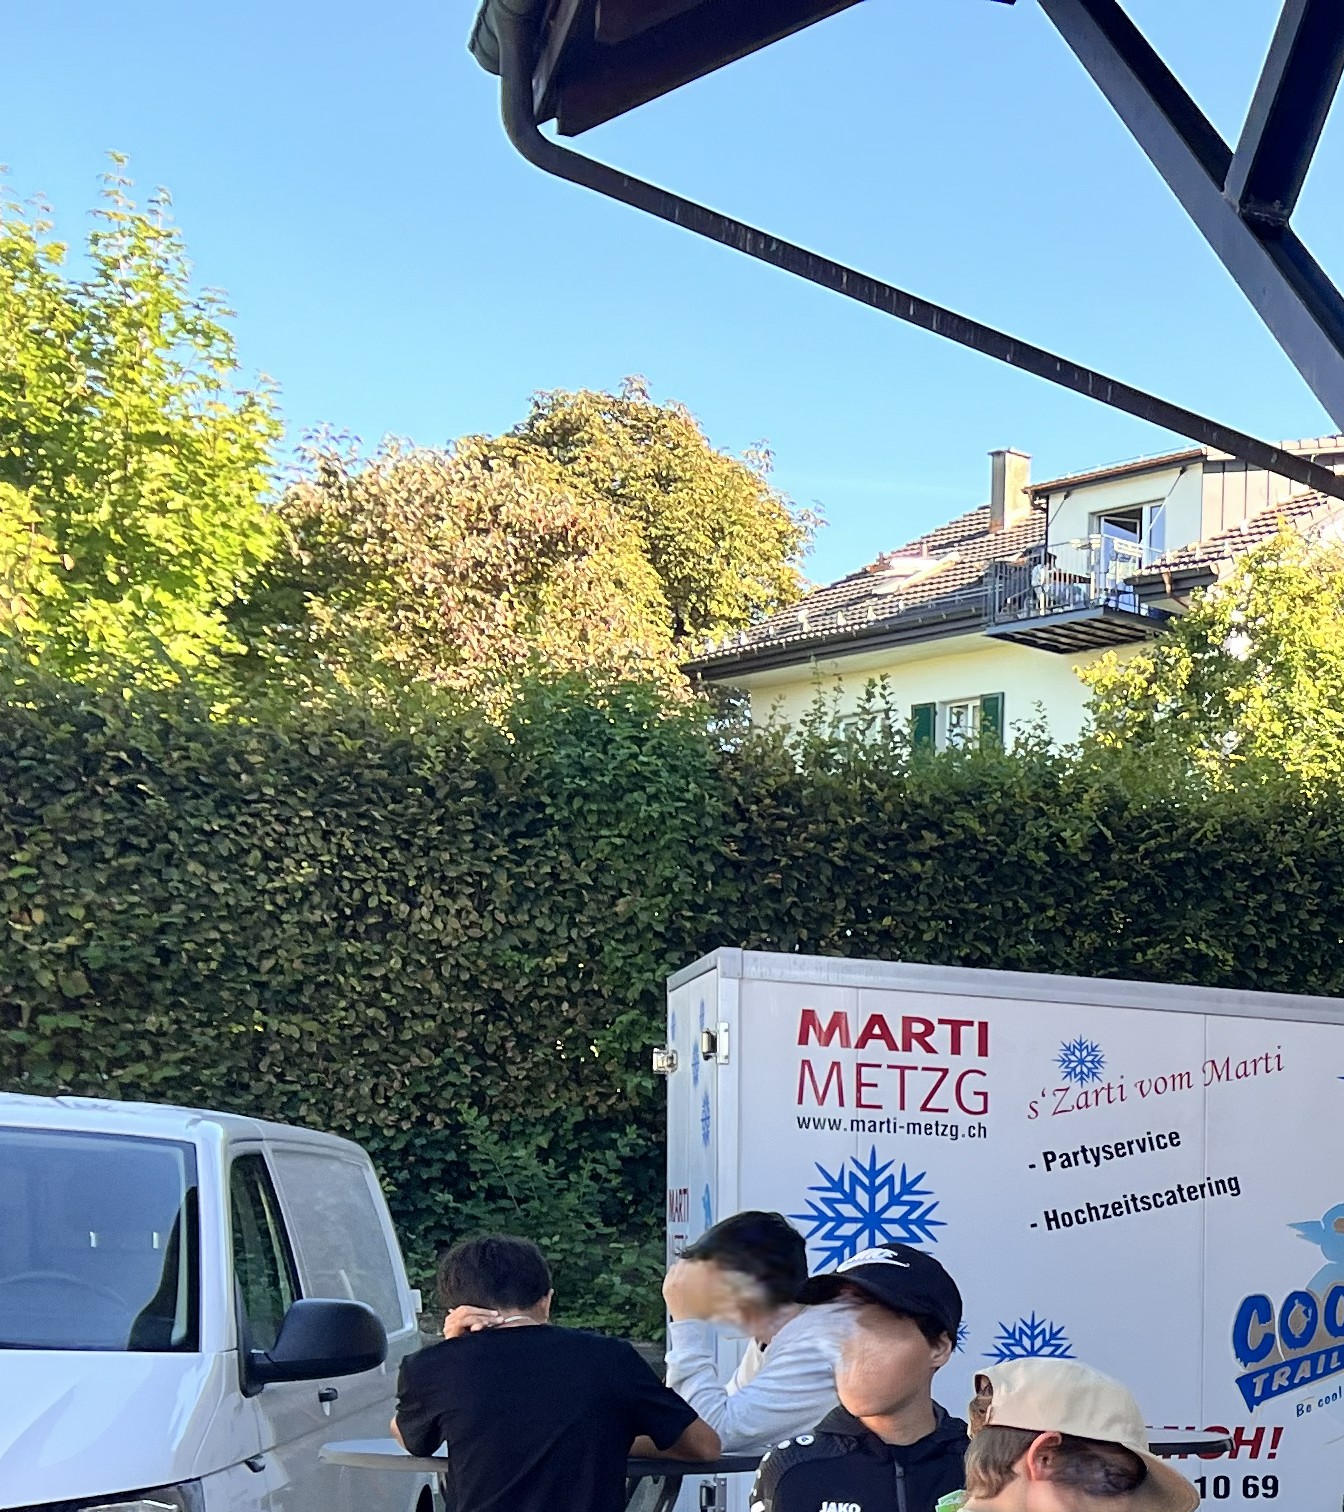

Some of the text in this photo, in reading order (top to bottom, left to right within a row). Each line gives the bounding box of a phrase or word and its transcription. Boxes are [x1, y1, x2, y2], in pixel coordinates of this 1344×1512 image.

[797, 1008, 989, 1058] MARTI
[797, 1059, 989, 1115] METZG
[1134, 1071, 1193, 1098] vom
[1201, 1045, 1285, 1087] Marti
[796, 1116, 987, 1141] www.marti-metzg.ch
[1042, 1131, 1181, 1172] Partyservice
[1043, 1176, 1241, 1231] Hochzeitscatering
[1296, 1402, 1312, 1418] Be
[1317, 1385, 1342, 1408] cool
[1242, 1475, 1279, 1499] 69
